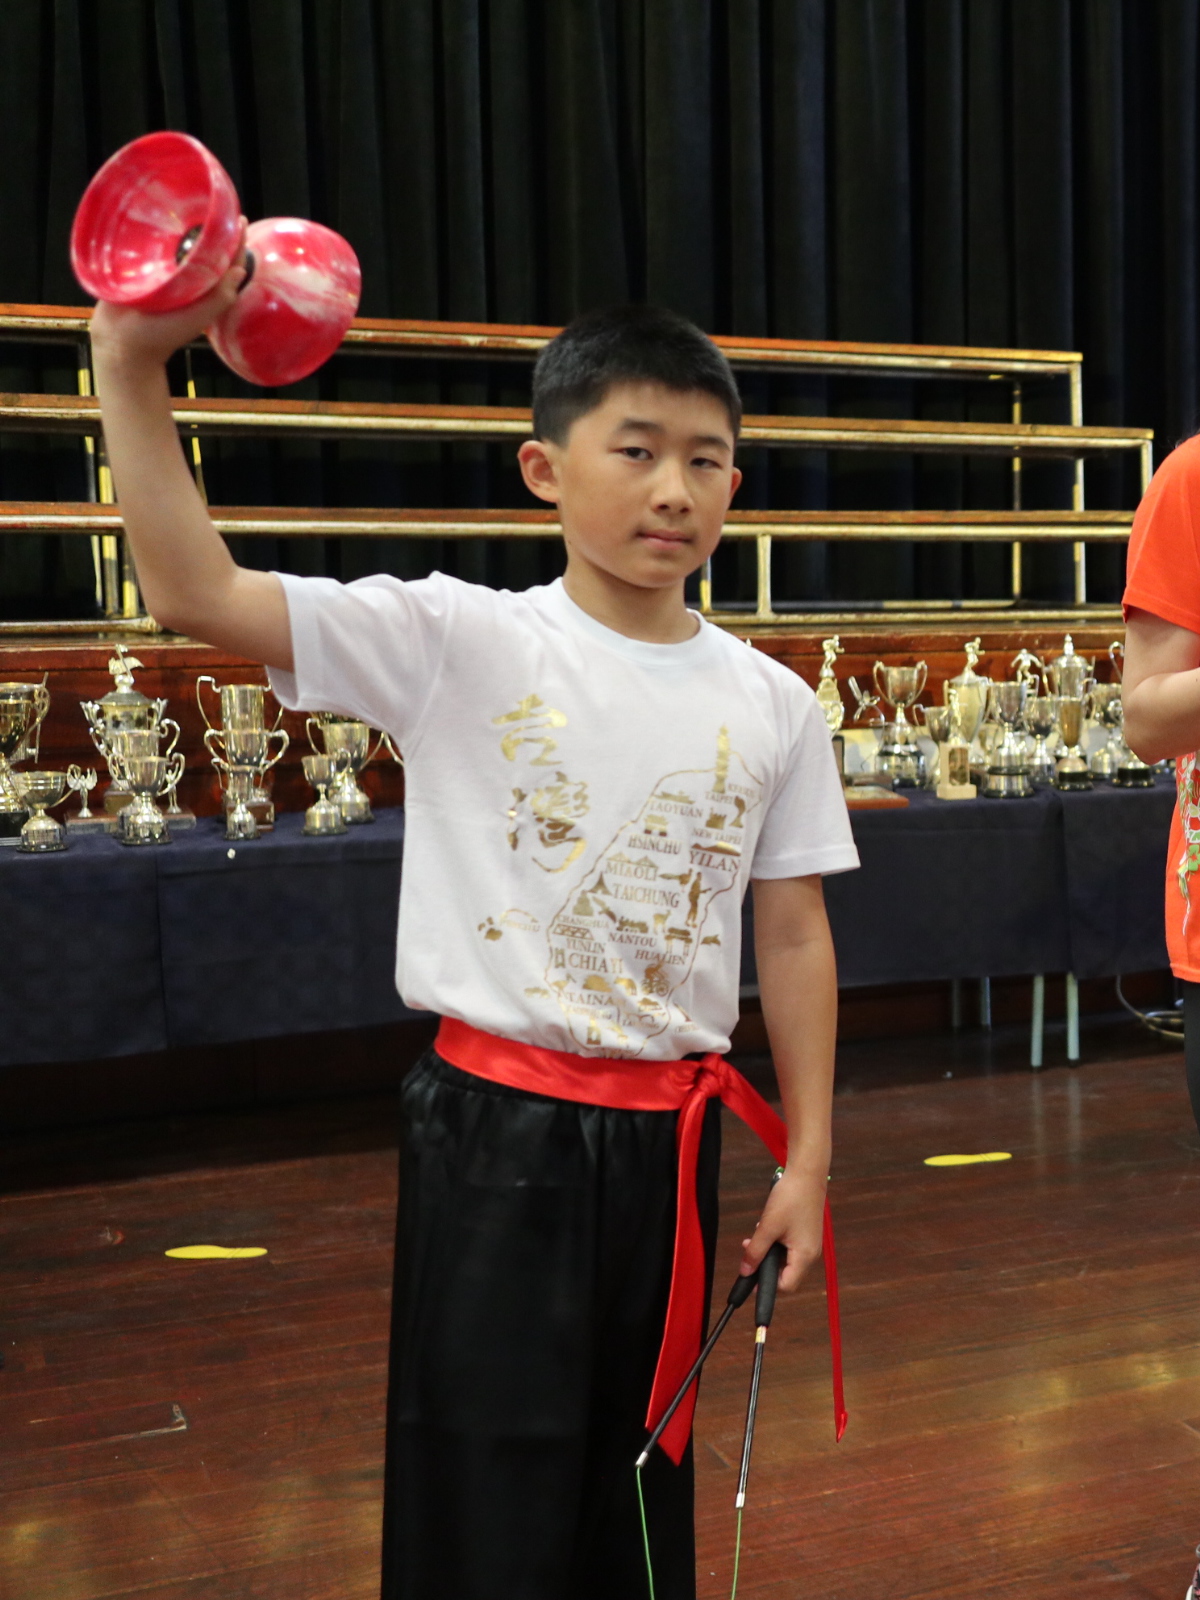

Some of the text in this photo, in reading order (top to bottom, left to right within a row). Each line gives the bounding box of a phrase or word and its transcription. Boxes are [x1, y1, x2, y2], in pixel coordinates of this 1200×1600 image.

[650, 801, 704, 818] TAOYUAN
[628, 835, 682, 855] HSINCHU
[605, 861, 658, 881] MIAOLI
[689, 850, 741, 872] YILAN
[613, 883, 680, 908] TAICHUNG
[566, 938, 607, 954] YUNLIN
[608, 932, 657, 948] NANTOU
